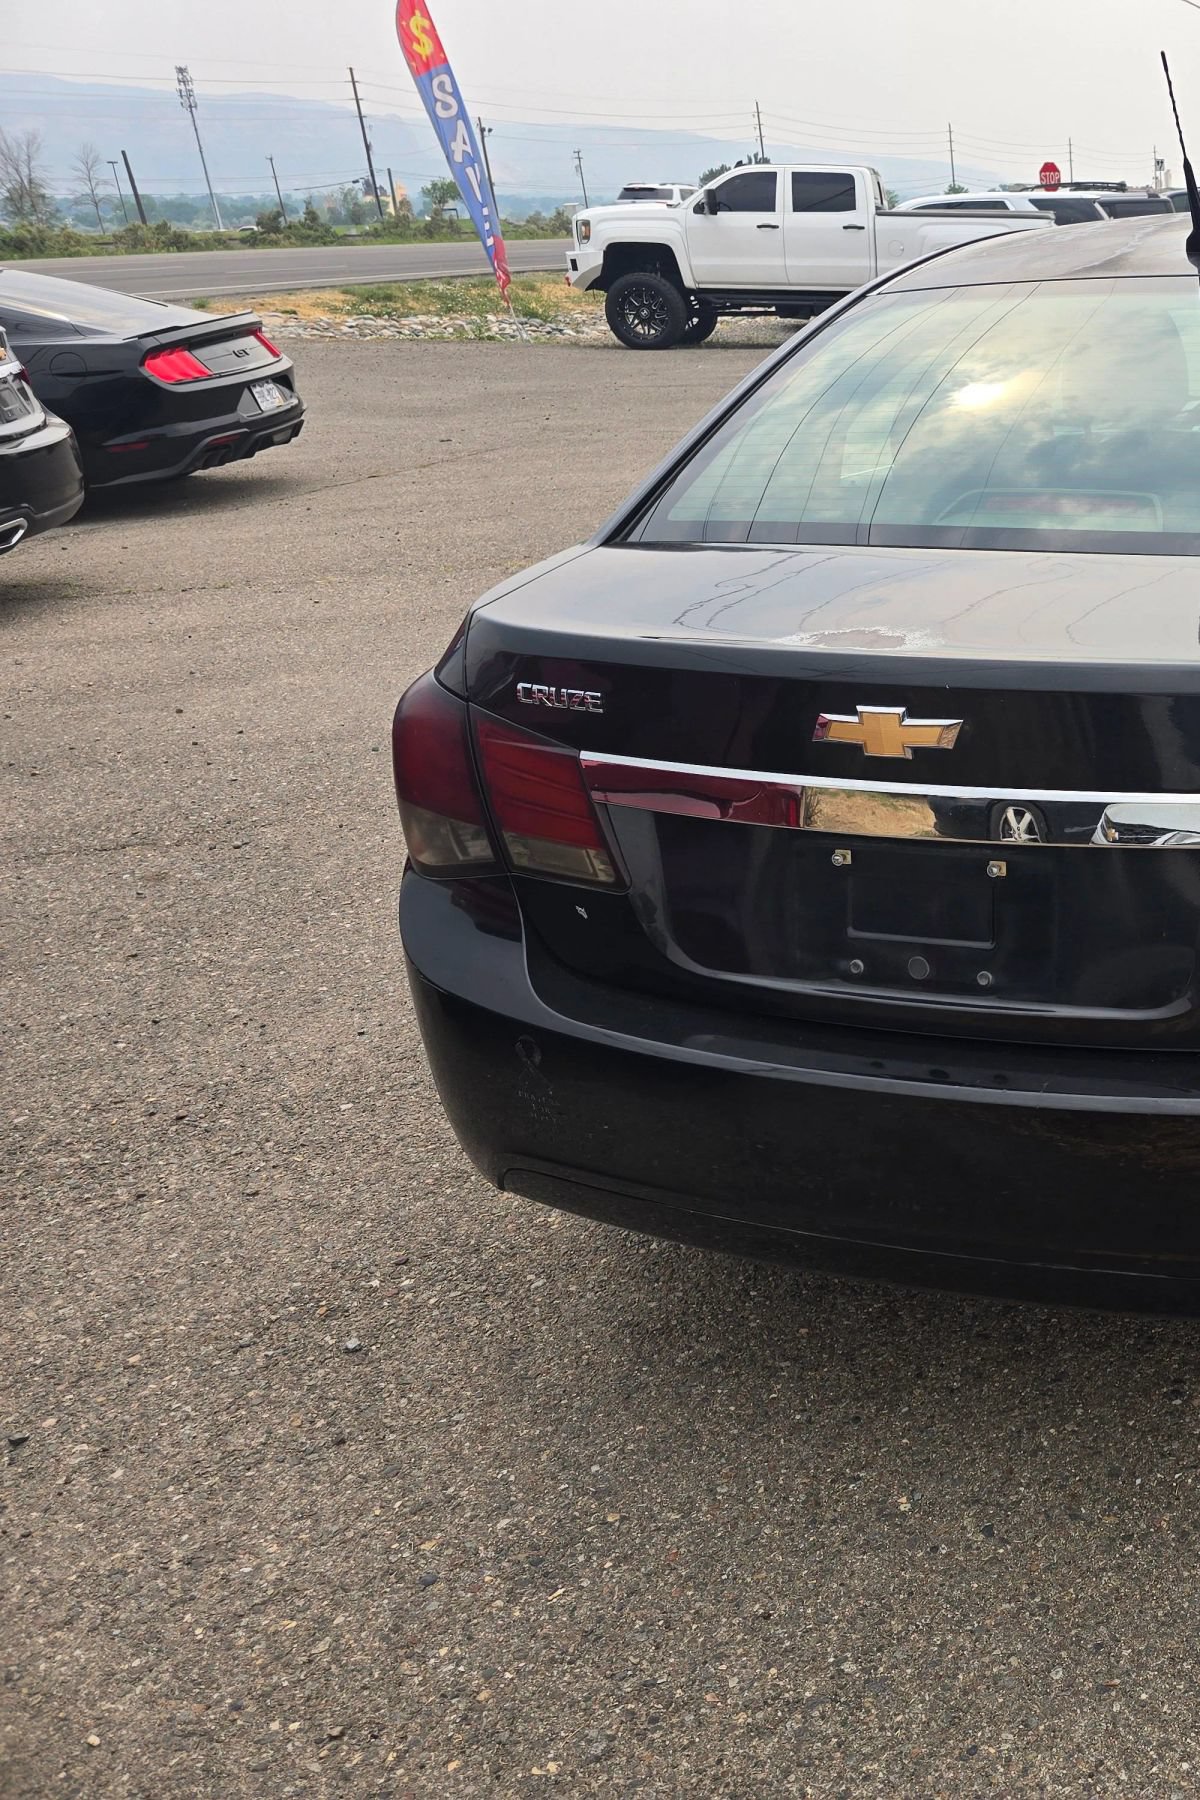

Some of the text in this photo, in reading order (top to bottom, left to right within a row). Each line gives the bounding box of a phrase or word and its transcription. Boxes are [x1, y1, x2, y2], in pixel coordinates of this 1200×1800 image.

[409, 10, 433, 61] $
[1041, 172, 1060, 184] STOP
[232, 347, 250, 358] GT
[517, 682, 604, 713] CRUZE
